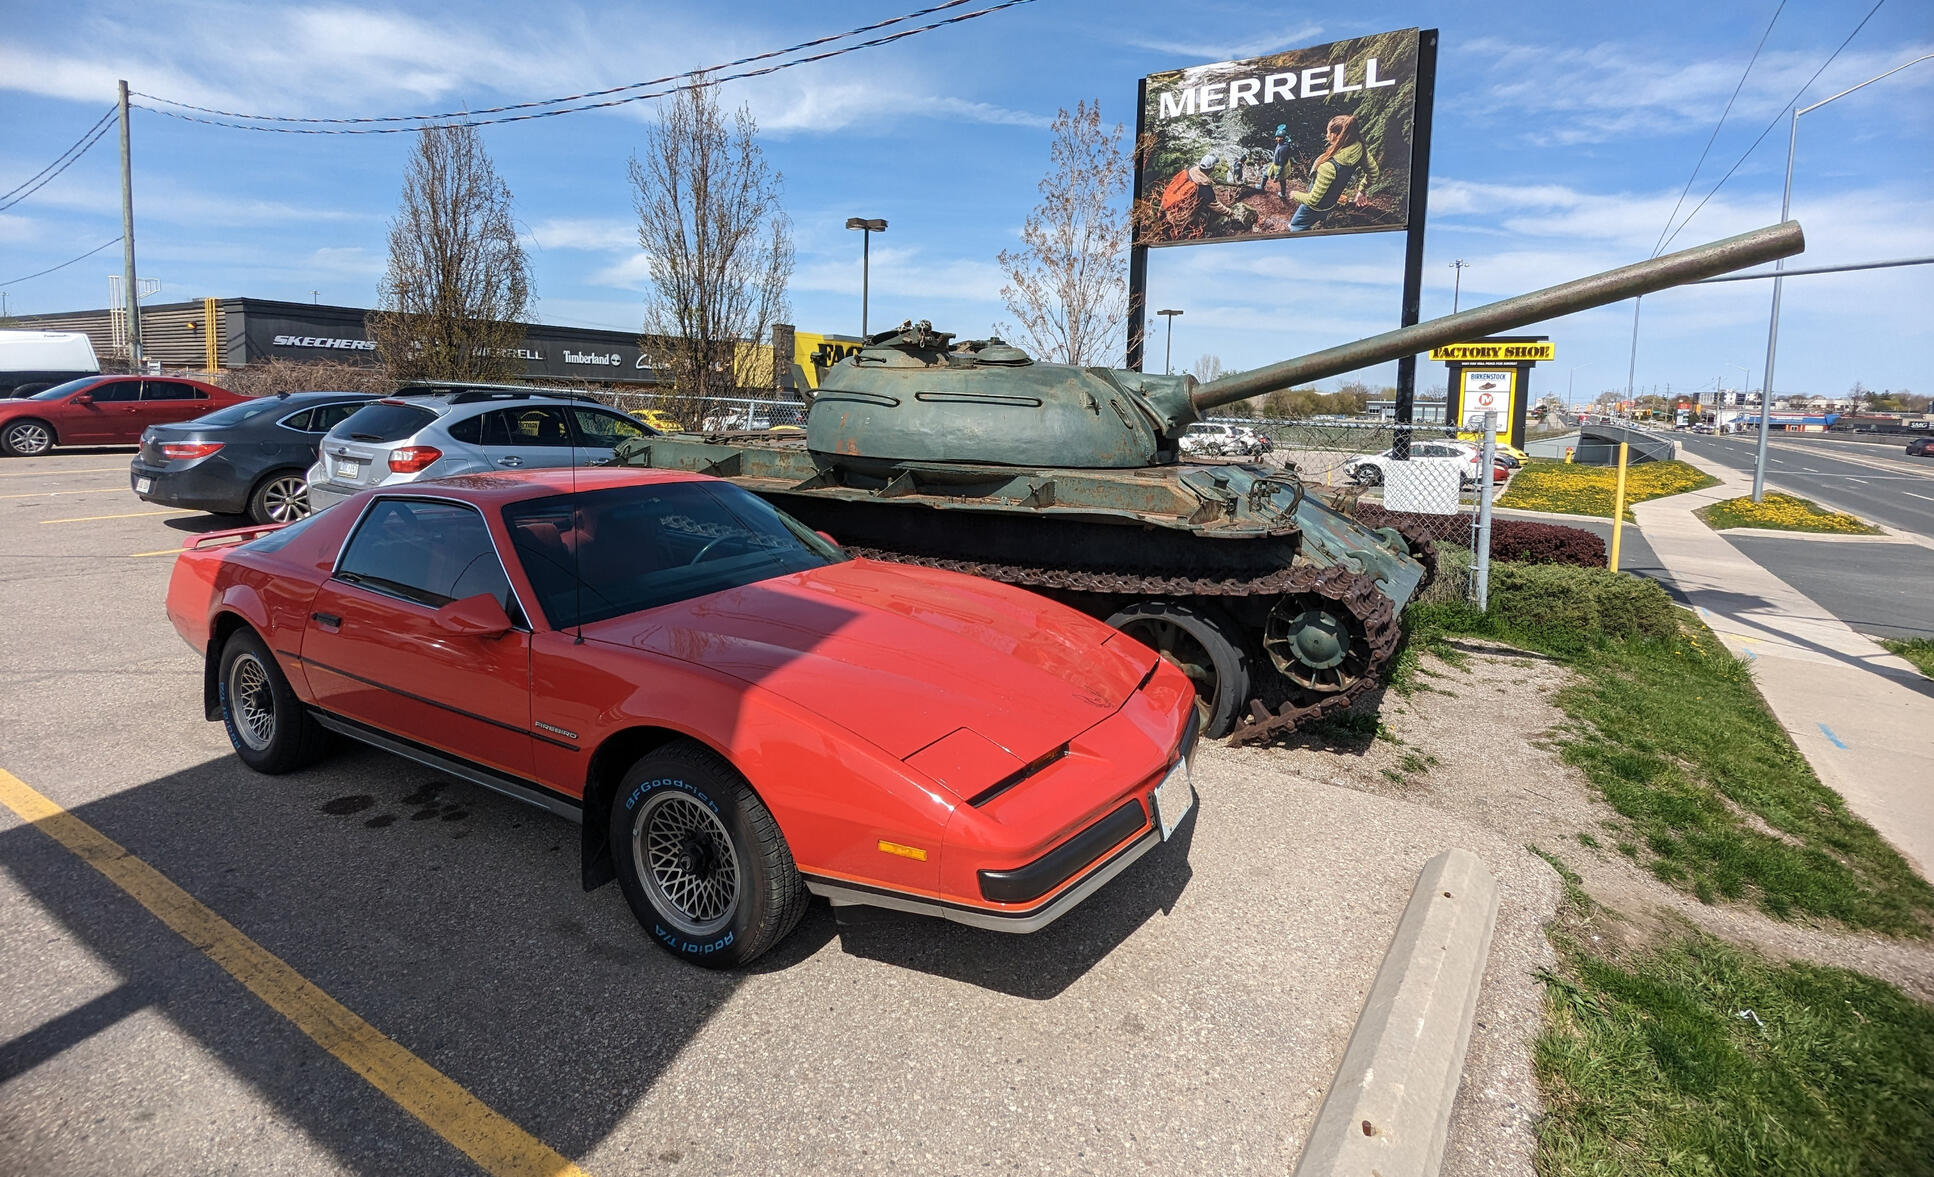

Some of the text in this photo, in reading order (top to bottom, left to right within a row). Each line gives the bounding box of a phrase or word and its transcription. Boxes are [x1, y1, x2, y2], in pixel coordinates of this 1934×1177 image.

[1159, 58, 1396, 119] MERRELL
[272, 335, 378, 350] SKECHERS
[562, 350, 610, 365] Timberland
[1433, 346, 1550, 358] FACTORY SHOE
[535, 721, 578, 739] FIREBIRD
[625, 778, 719, 813] BFGoodrich
[681, 930, 734, 954] Radial
